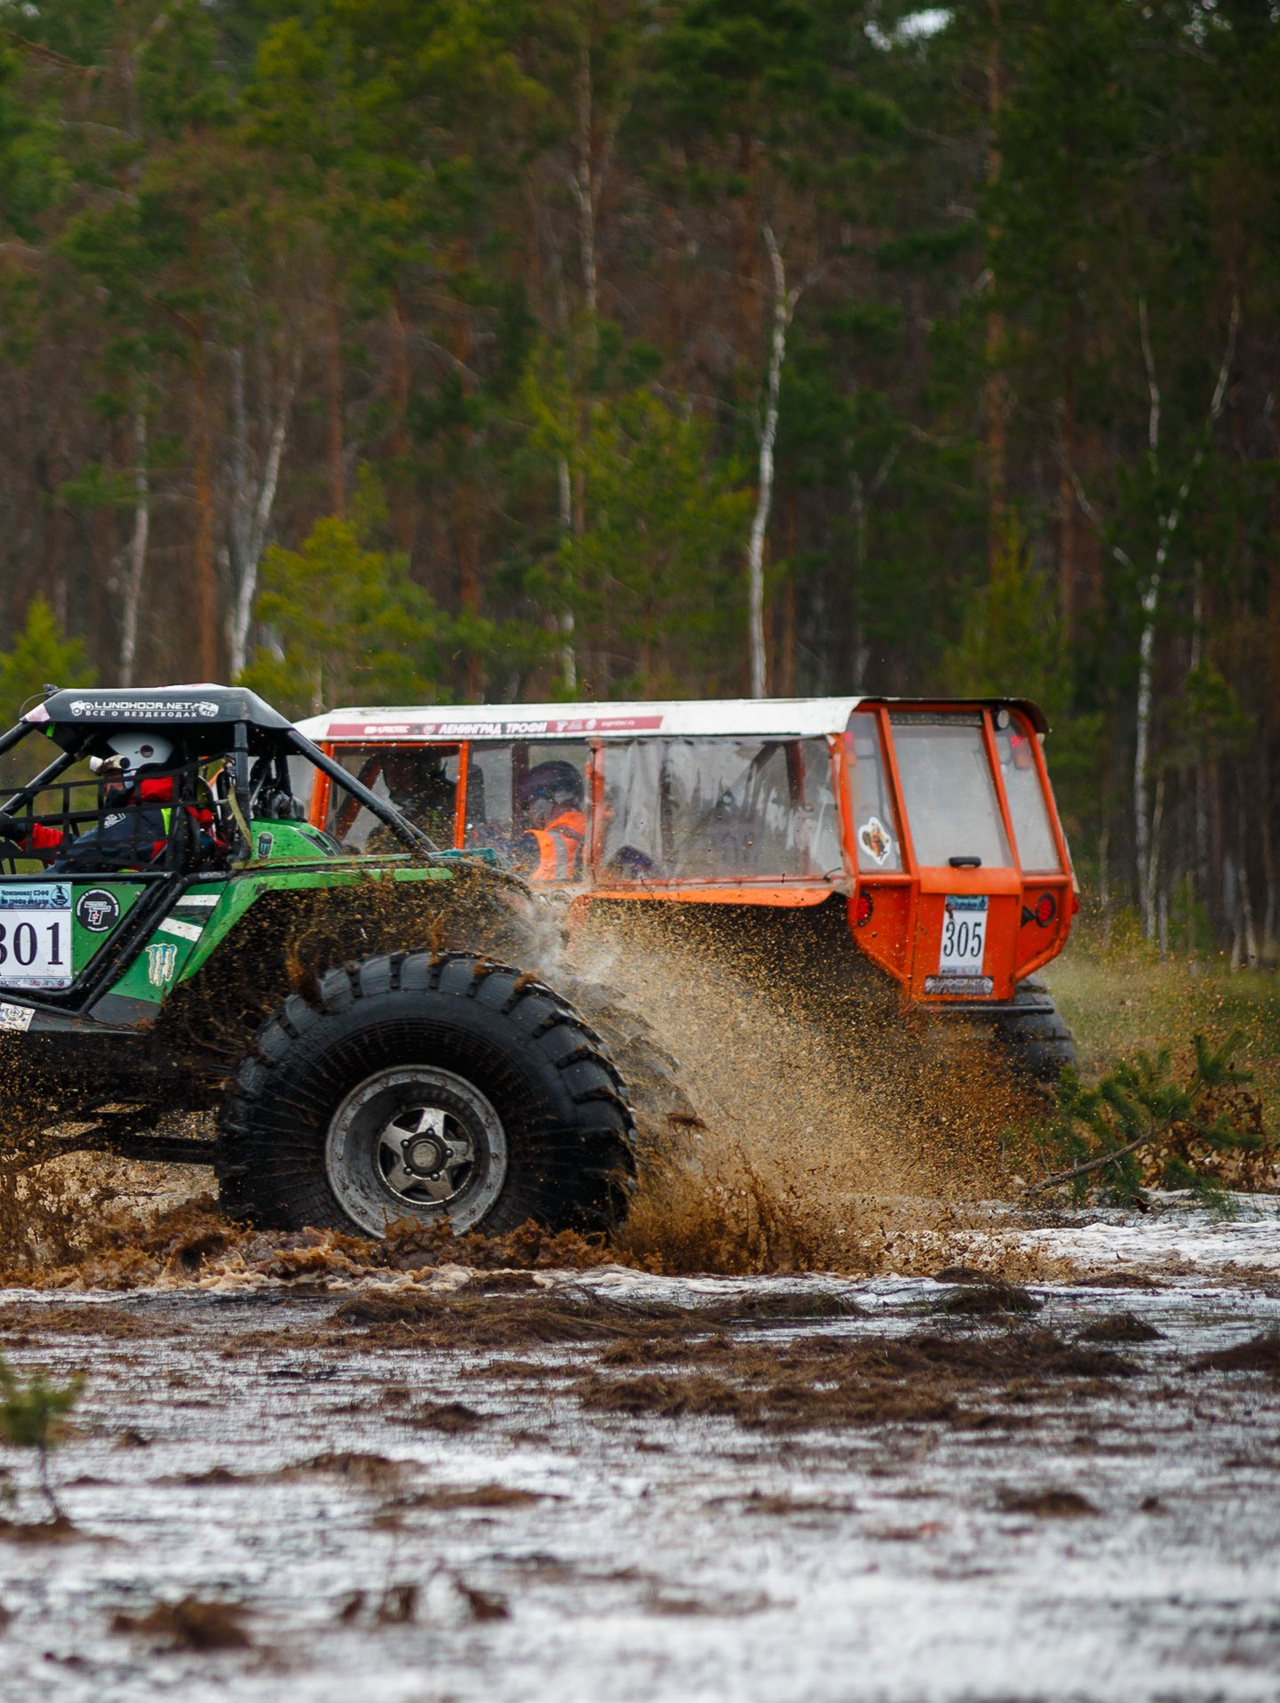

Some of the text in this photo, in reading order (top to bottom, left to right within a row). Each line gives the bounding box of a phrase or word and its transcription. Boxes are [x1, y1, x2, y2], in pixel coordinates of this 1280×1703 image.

[439, 720, 547, 734] ЛЕНИНГРАД ТРОФИ
[943, 921, 982, 957] 305
